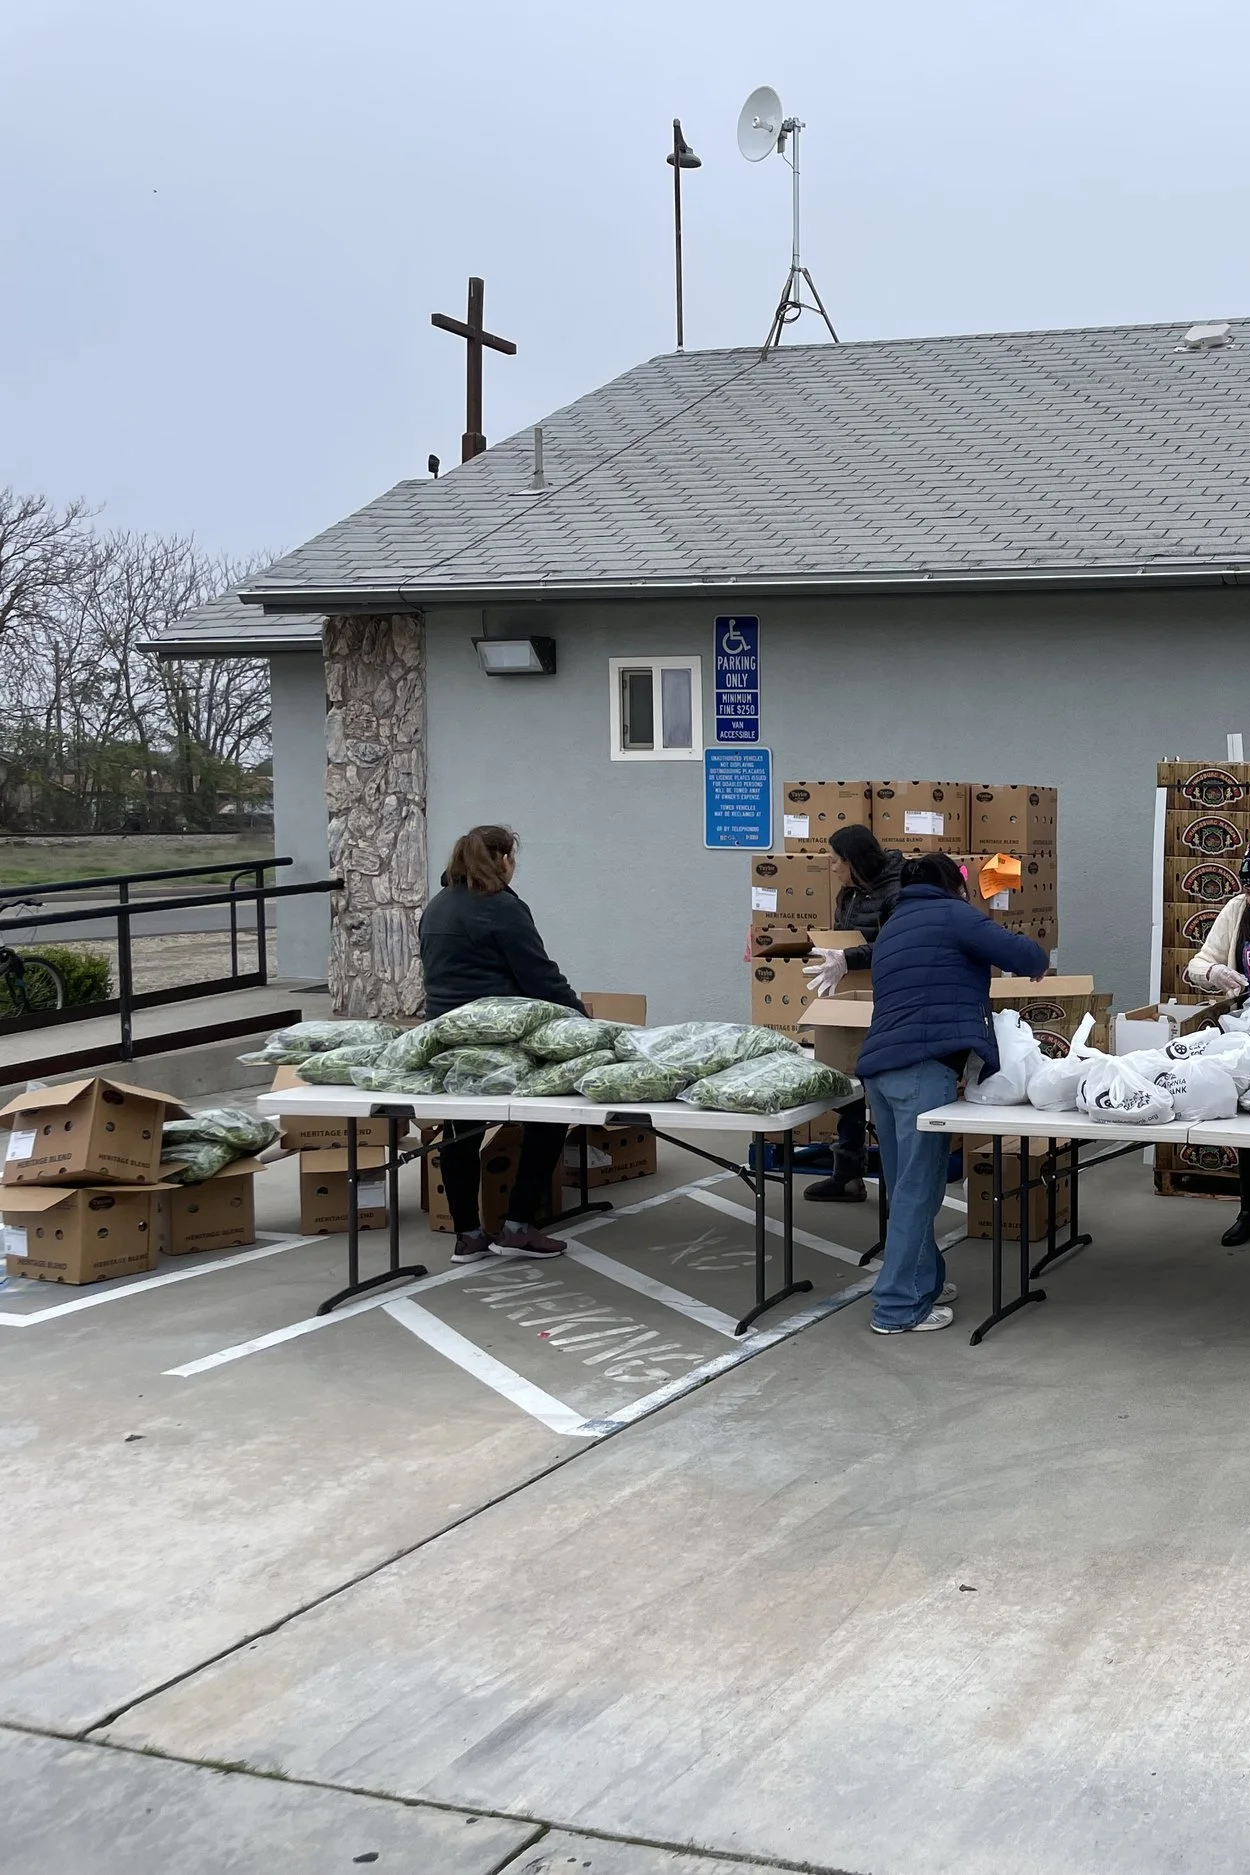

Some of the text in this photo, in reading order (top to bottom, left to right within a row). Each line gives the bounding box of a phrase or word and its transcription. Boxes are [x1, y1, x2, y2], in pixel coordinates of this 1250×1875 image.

[717, 655, 756, 671] PARKING
[725, 673, 748, 688] ONLY
[722, 693, 752, 704] MINIMUM
[719, 704, 755, 715] FINE $250
[731, 721, 744, 729] VAN
[719, 730, 756, 739] ACCESSIBLE
[343, 1128, 372, 1136] BND
[17, 1152, 73, 1169] HERITAGE BLEND
